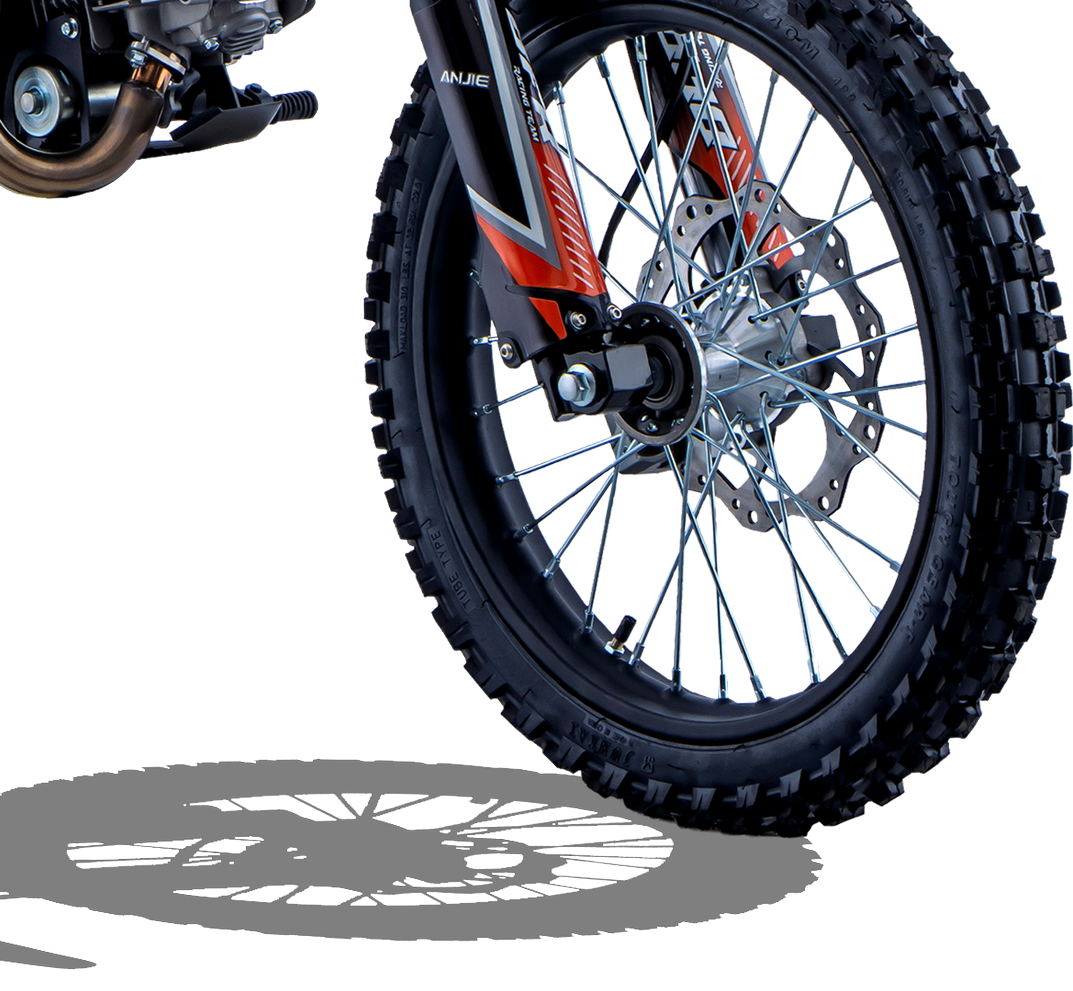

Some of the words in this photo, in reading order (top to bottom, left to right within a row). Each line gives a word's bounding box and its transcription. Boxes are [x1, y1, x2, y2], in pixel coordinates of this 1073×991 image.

[439, 69, 491, 90] ANJIE
[513, 64, 531, 108] RACING
[525, 109, 541, 144] TEAM
[430, 529, 453, 569] TYPE
[448, 571, 472, 609] TUBE
